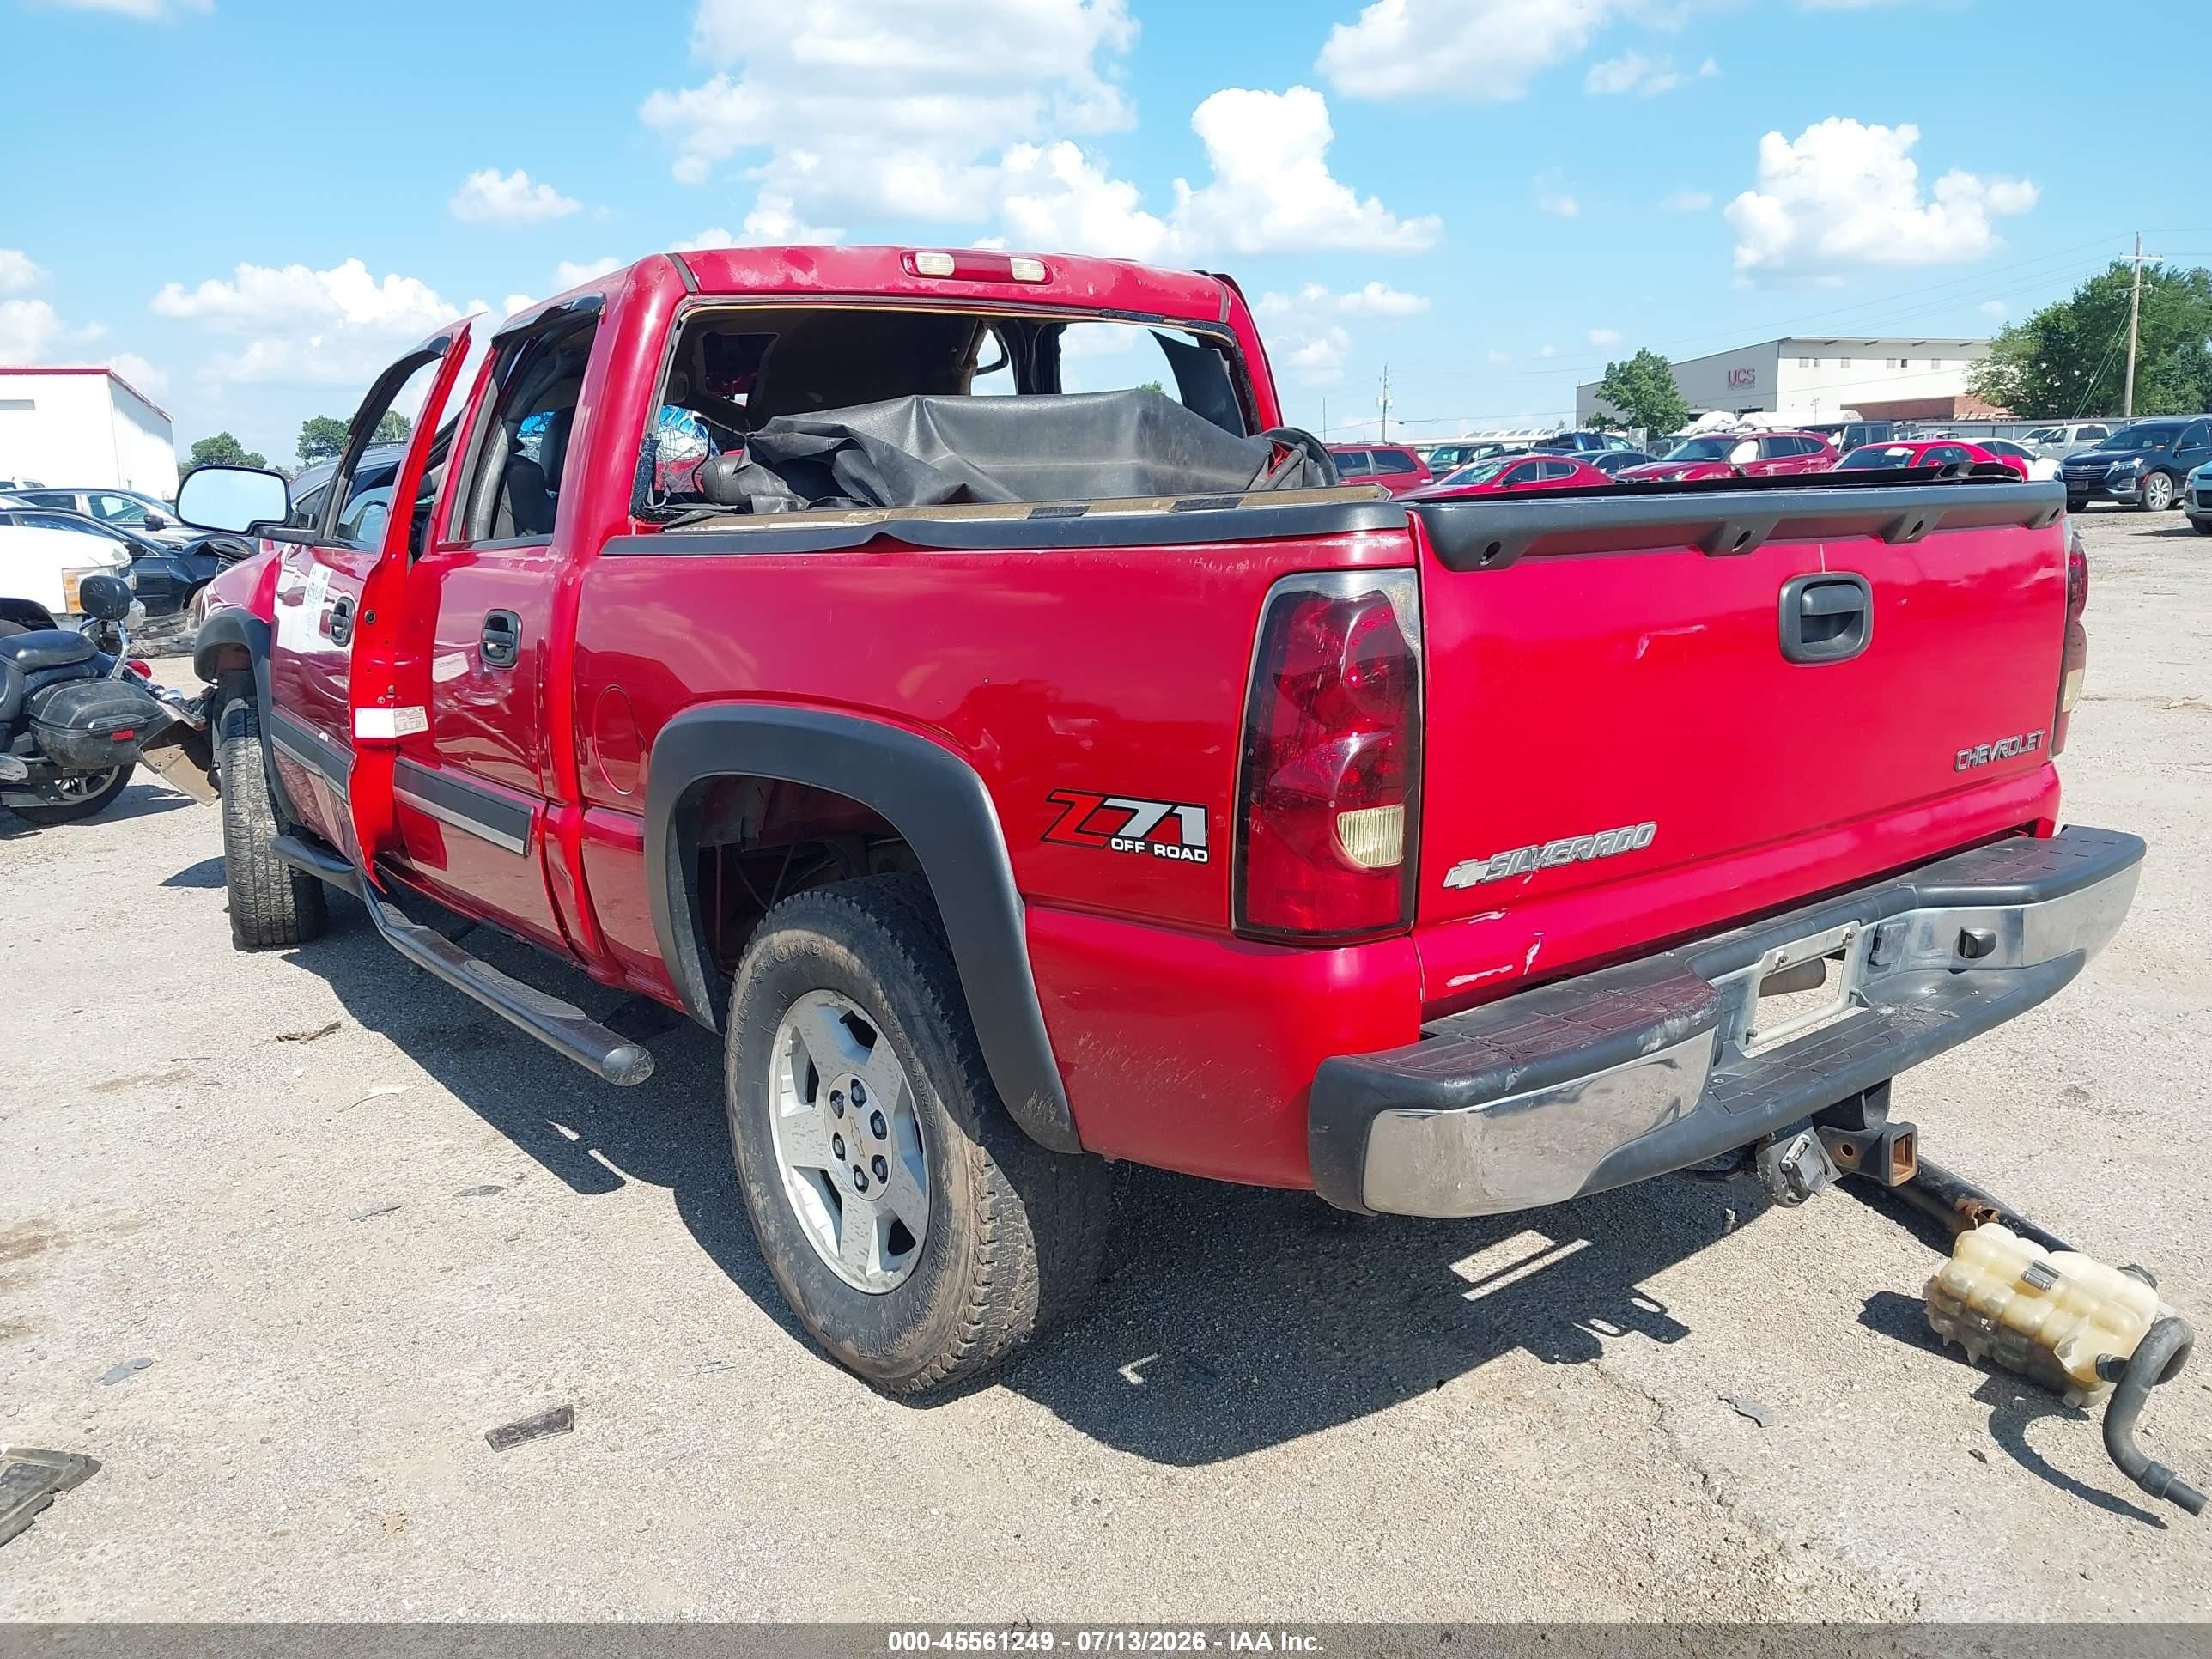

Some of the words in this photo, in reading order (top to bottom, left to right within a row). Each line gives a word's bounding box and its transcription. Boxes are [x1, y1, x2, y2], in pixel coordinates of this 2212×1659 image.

[1728, 368, 1756, 386] UCS
[1954, 728, 2046, 772] CHEVROLET
[1040, 788, 1209, 849] Z71
[1110, 837, 1146, 854] OFF
[1152, 842, 1208, 863] ROAD
[1480, 821, 1657, 883] SILVERADO
